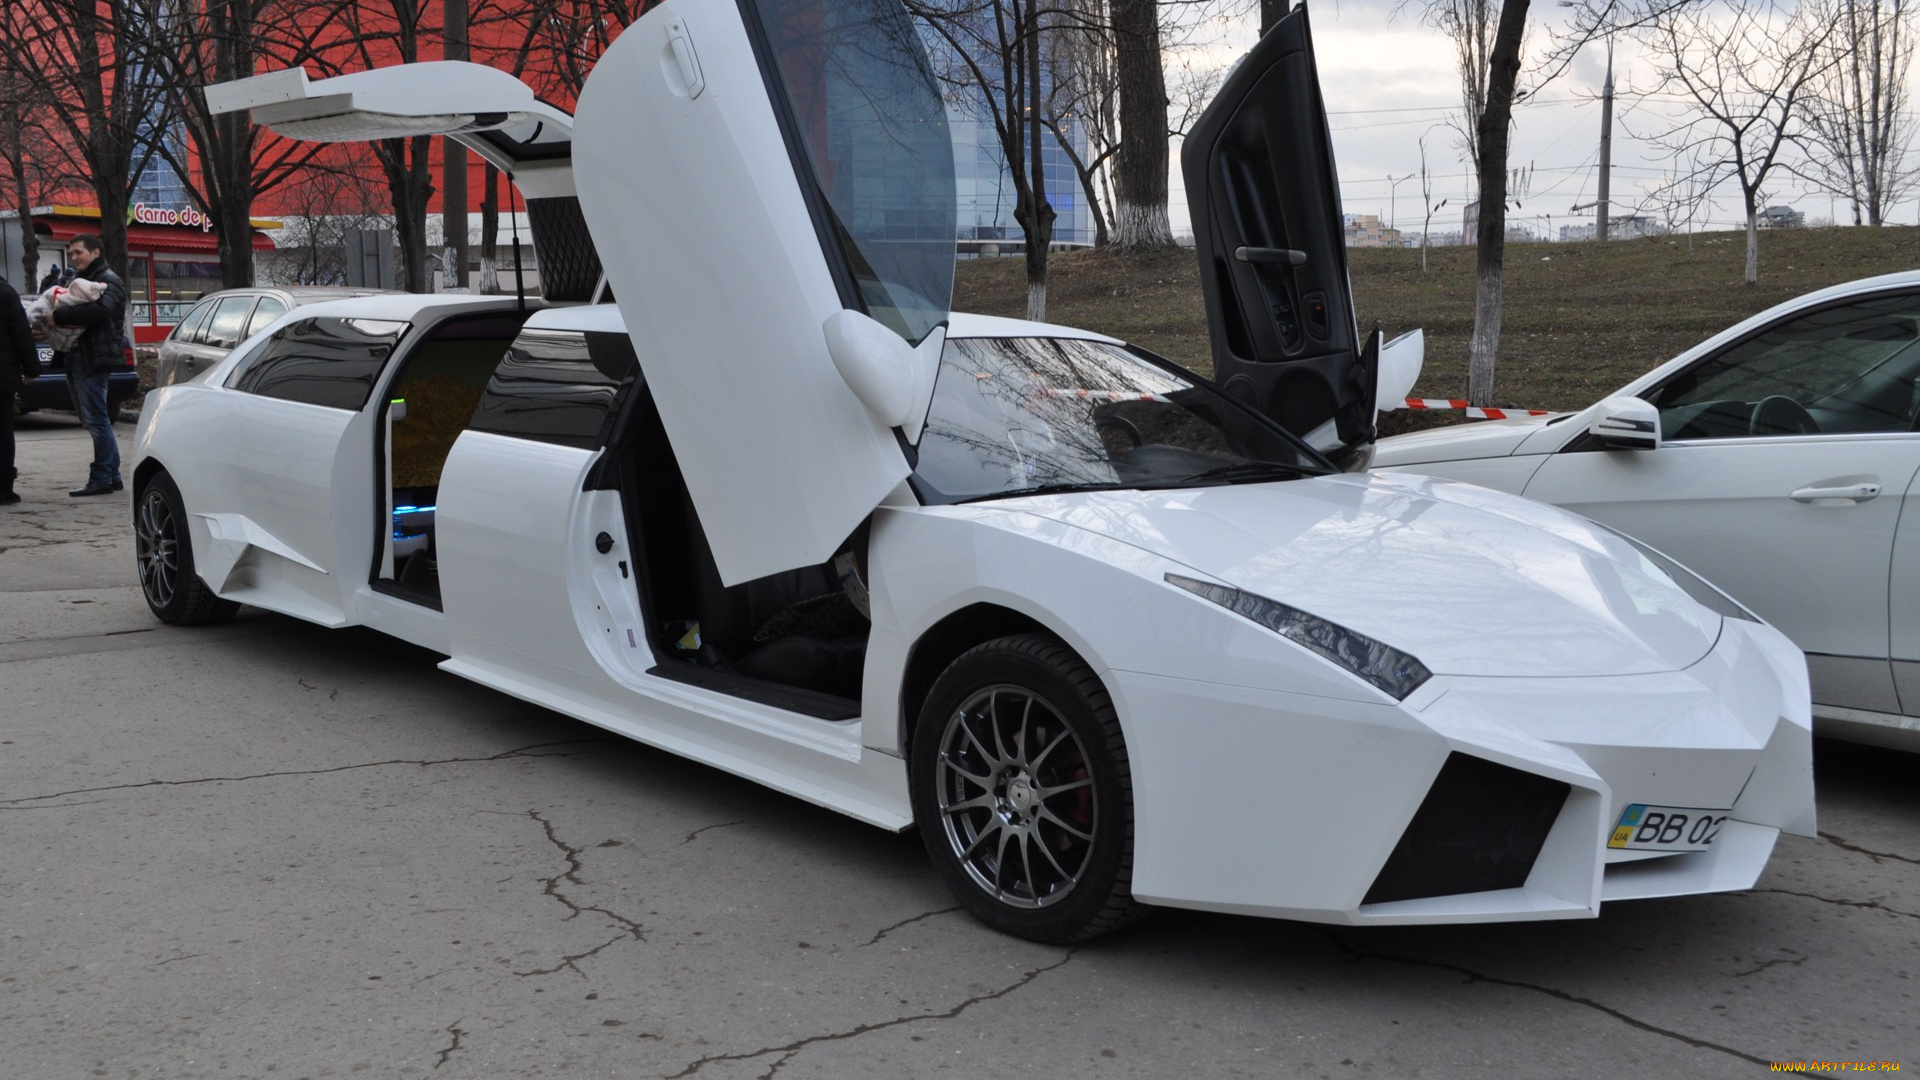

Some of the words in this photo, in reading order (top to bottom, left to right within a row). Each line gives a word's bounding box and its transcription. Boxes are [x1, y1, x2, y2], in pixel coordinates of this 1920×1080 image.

[135, 203, 177, 225] Carne
[181, 205, 200, 226] de
[1614, 832, 1628, 841] UA
[1634, 812, 1688, 843] BB
